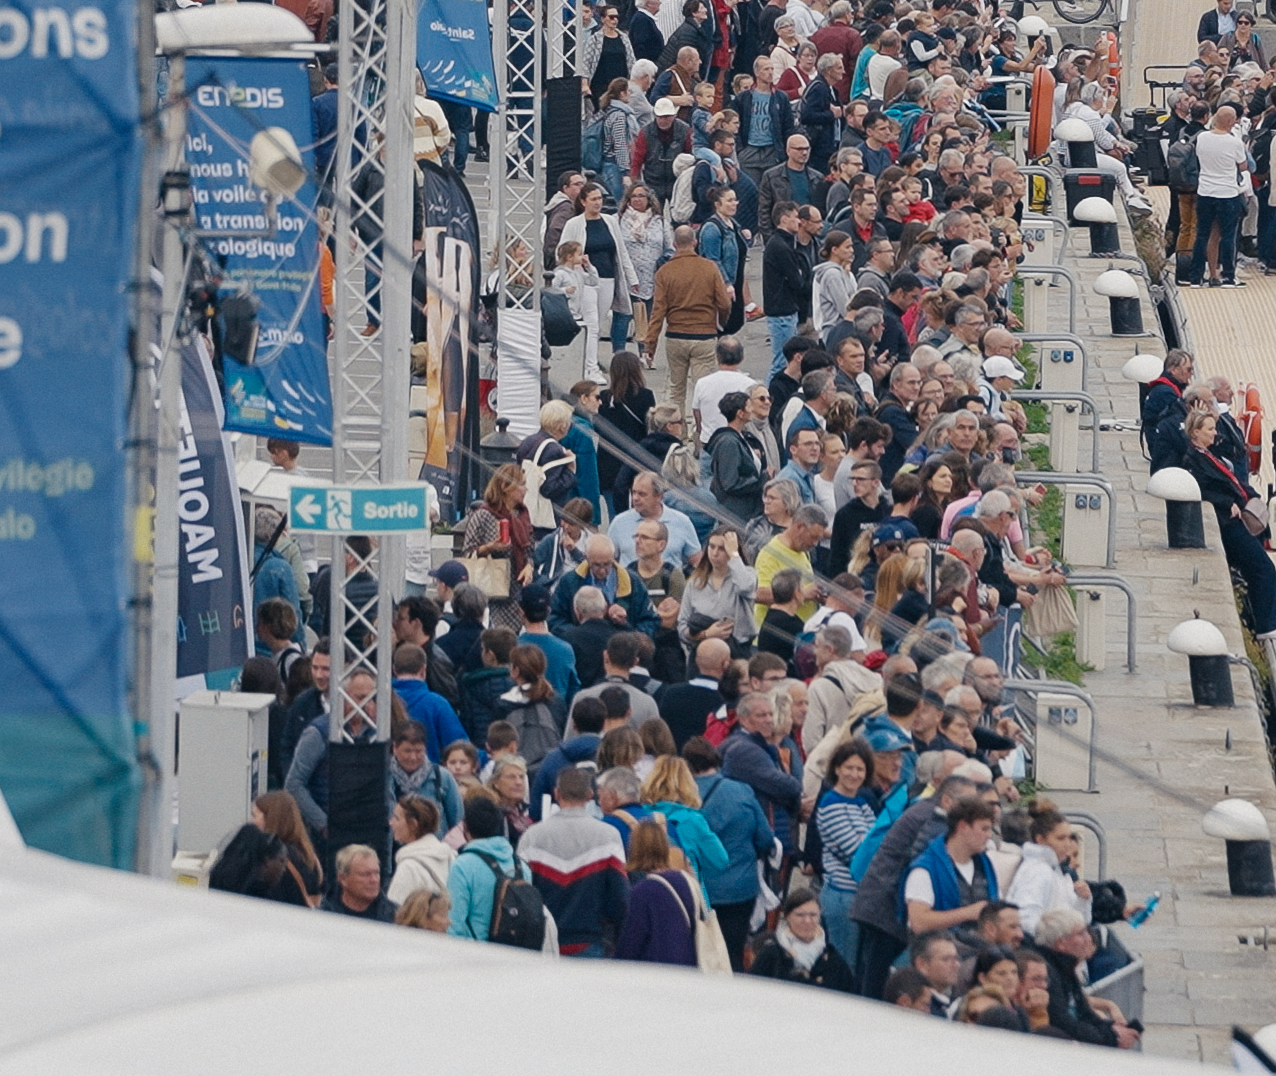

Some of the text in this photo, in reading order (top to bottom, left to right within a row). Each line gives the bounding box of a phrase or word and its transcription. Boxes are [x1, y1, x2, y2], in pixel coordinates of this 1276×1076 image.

[190, 164, 233, 178] nous
[215, 212, 305, 234] transiion
[363, 501, 419, 520] Sortie
